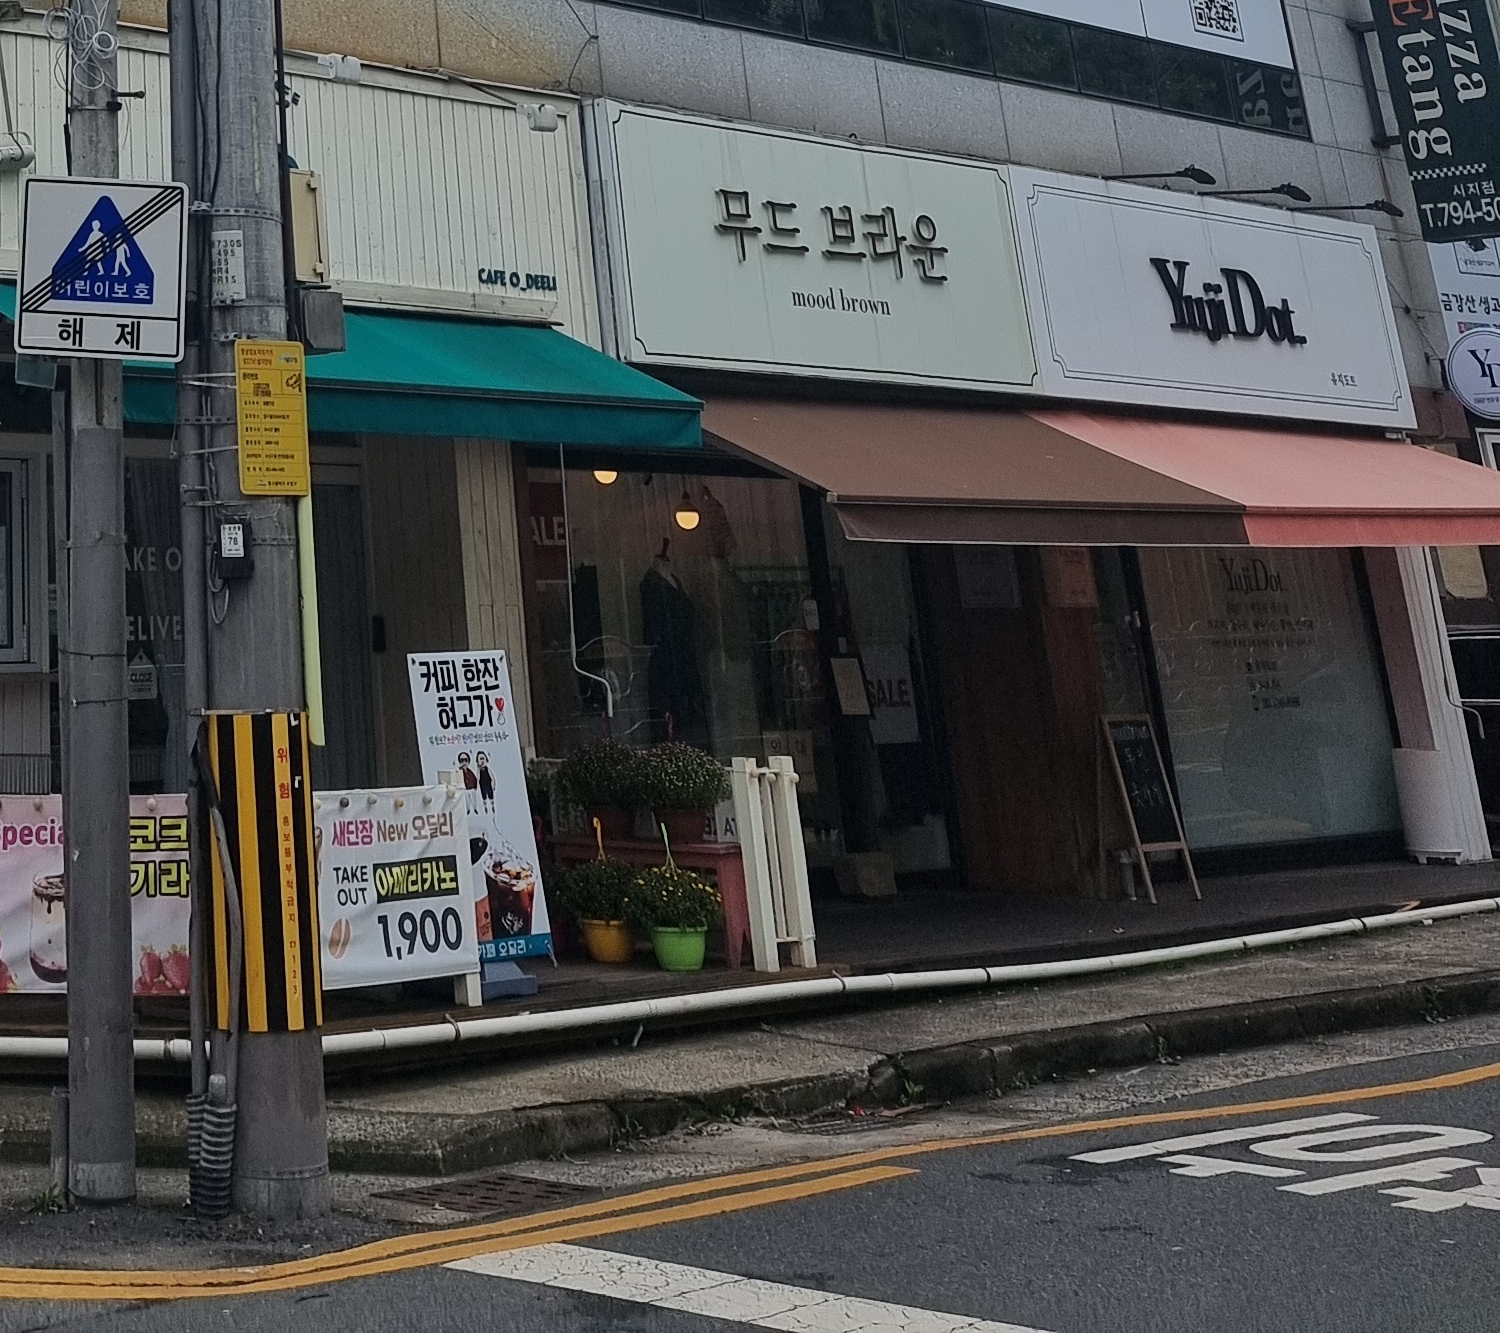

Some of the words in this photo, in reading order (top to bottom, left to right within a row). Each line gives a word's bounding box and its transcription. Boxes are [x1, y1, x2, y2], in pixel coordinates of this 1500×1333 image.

[1453, 180, 1497, 199] 시지점
[715, 188, 809, 263] 무드
[820, 205, 949, 283] 브라운
[478, 268, 506, 287] CAFE
[791, 287, 837, 312] mood
[841, 290, 892, 316] brown
[419, 660, 459, 693] 커피
[462, 658, 500, 691] 한잔
[332, 818, 373, 847] 새단장
[377, 821, 408, 843] New
[411, 812, 454, 841] 오딜리
[332, 865, 368, 883] TAKE
[375, 862, 457, 897] 아메리카노
[337, 888, 367, 906] OUT
[378, 907, 463, 960] 1,900
